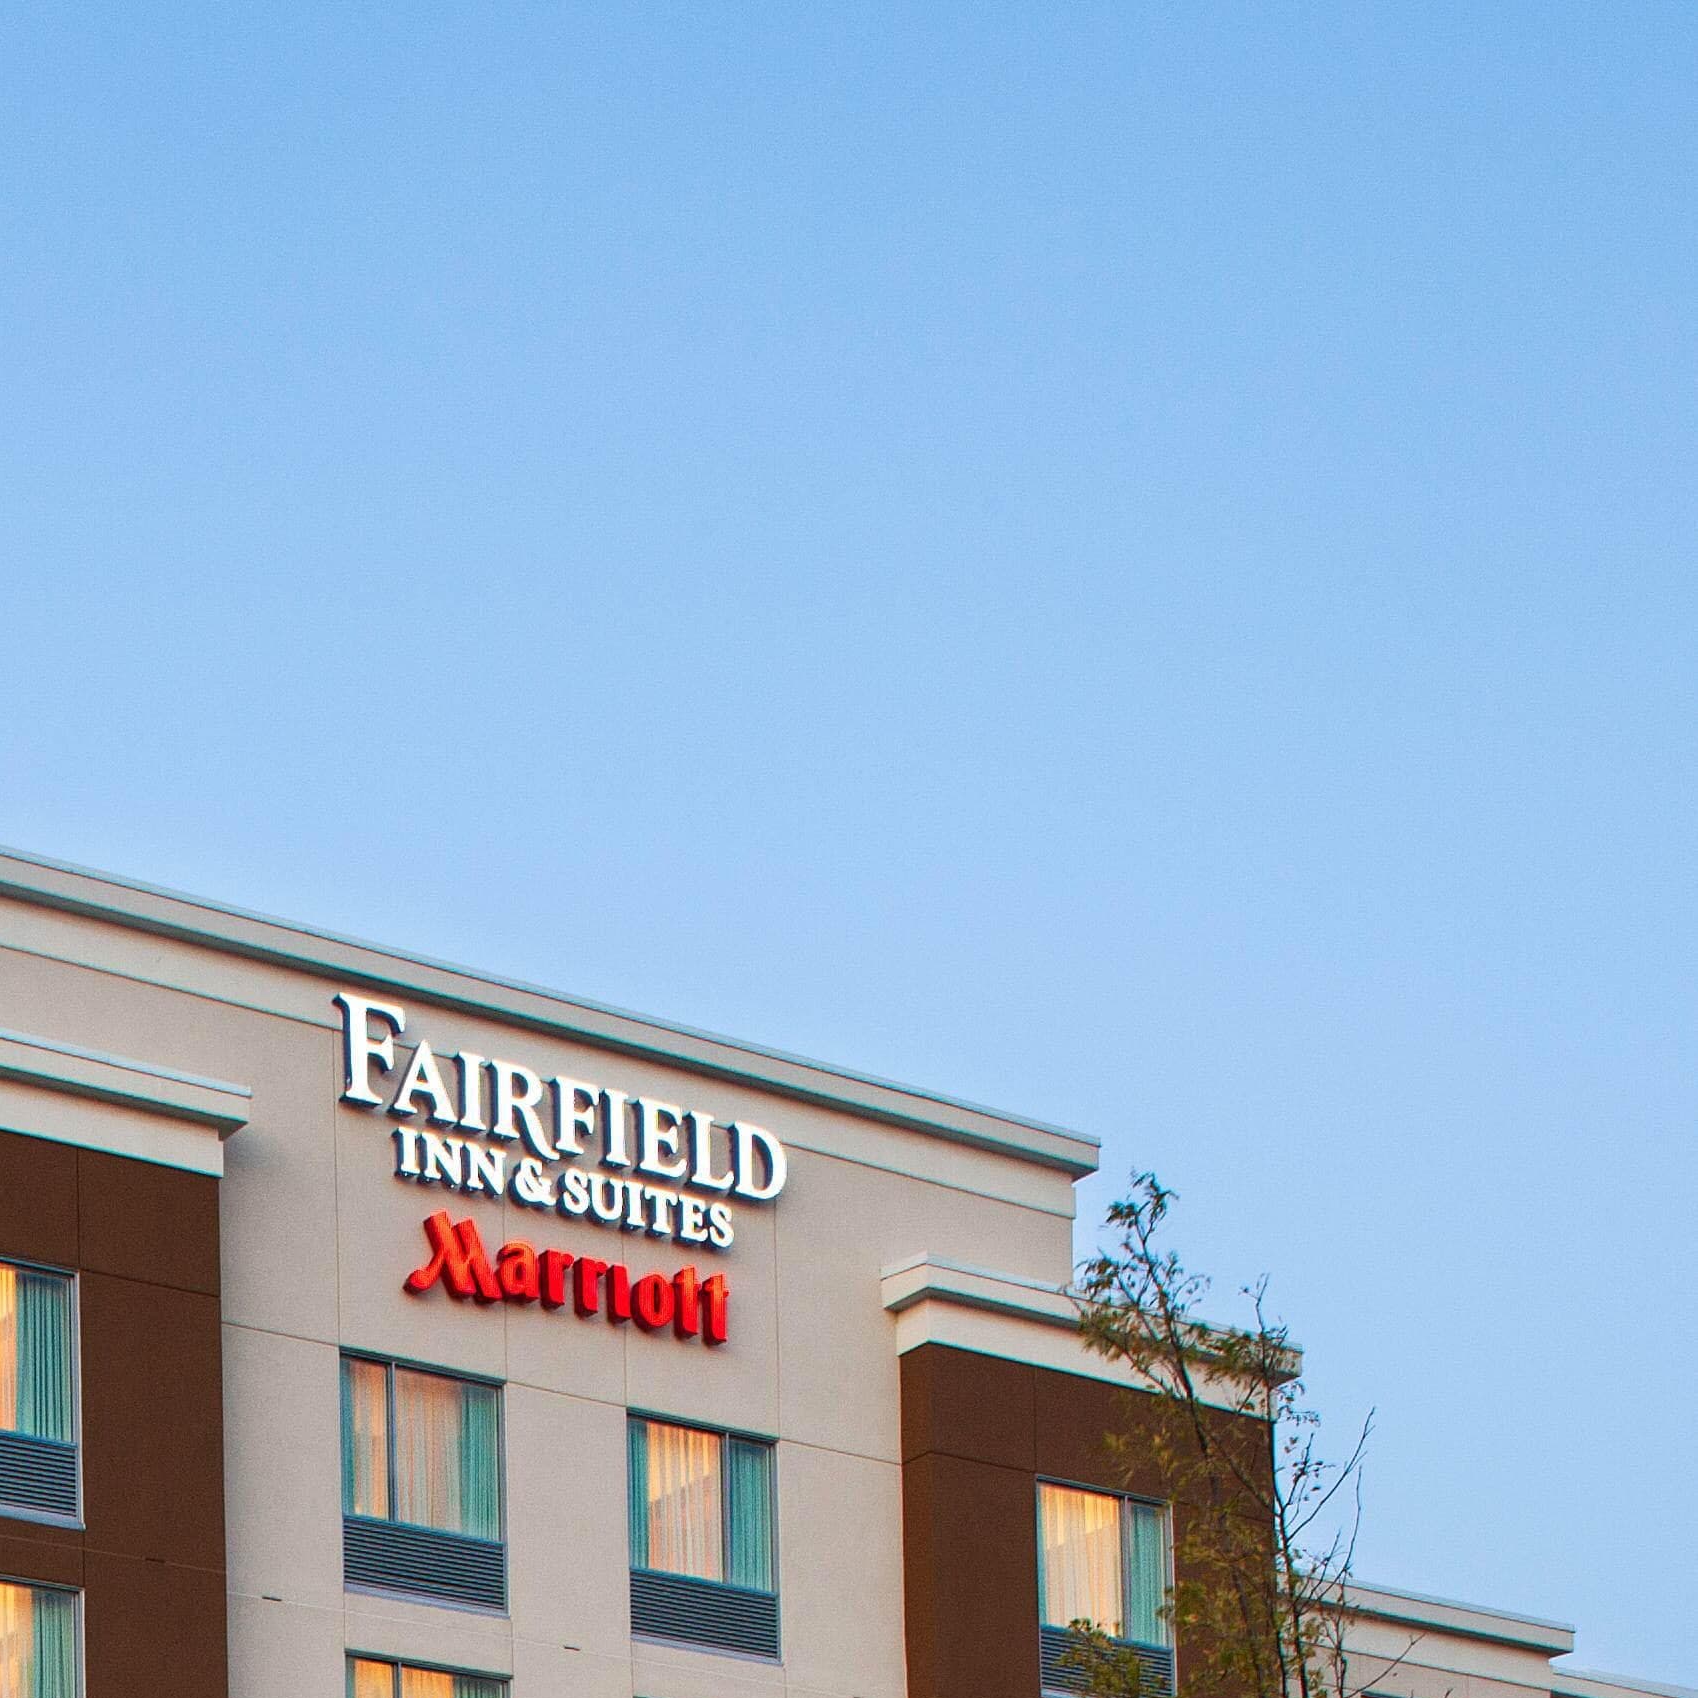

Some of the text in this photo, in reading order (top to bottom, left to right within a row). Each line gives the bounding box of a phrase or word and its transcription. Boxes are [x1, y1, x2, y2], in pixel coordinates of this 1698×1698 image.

[333, 991, 788, 1201] FAIRFIELD
[393, 1126, 735, 1251] INN & SUITES
[403, 1207, 730, 1344] Marriott
